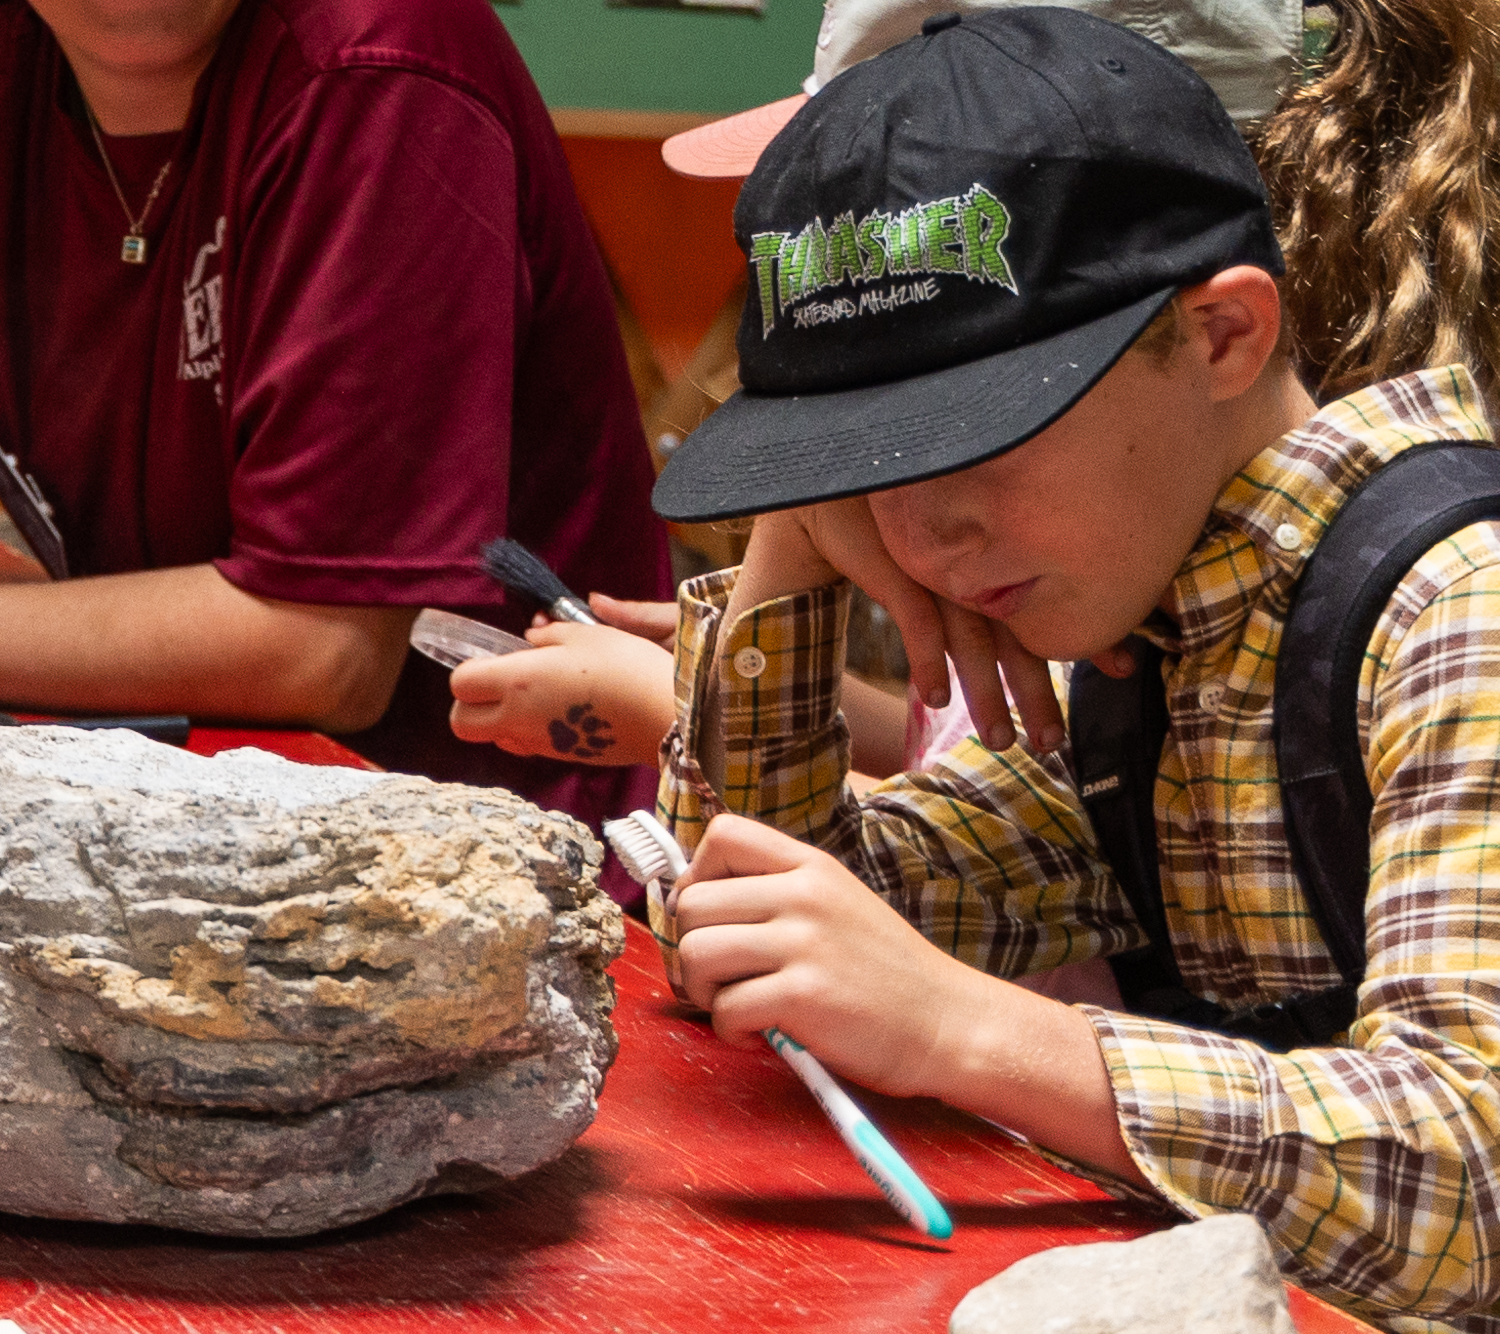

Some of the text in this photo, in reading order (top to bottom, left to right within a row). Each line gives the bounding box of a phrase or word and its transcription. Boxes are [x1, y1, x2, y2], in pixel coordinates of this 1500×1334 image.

[750, 182, 1019, 341] THRASHER
[792, 277, 942, 329] SKATEBOARD MAGAZINE
